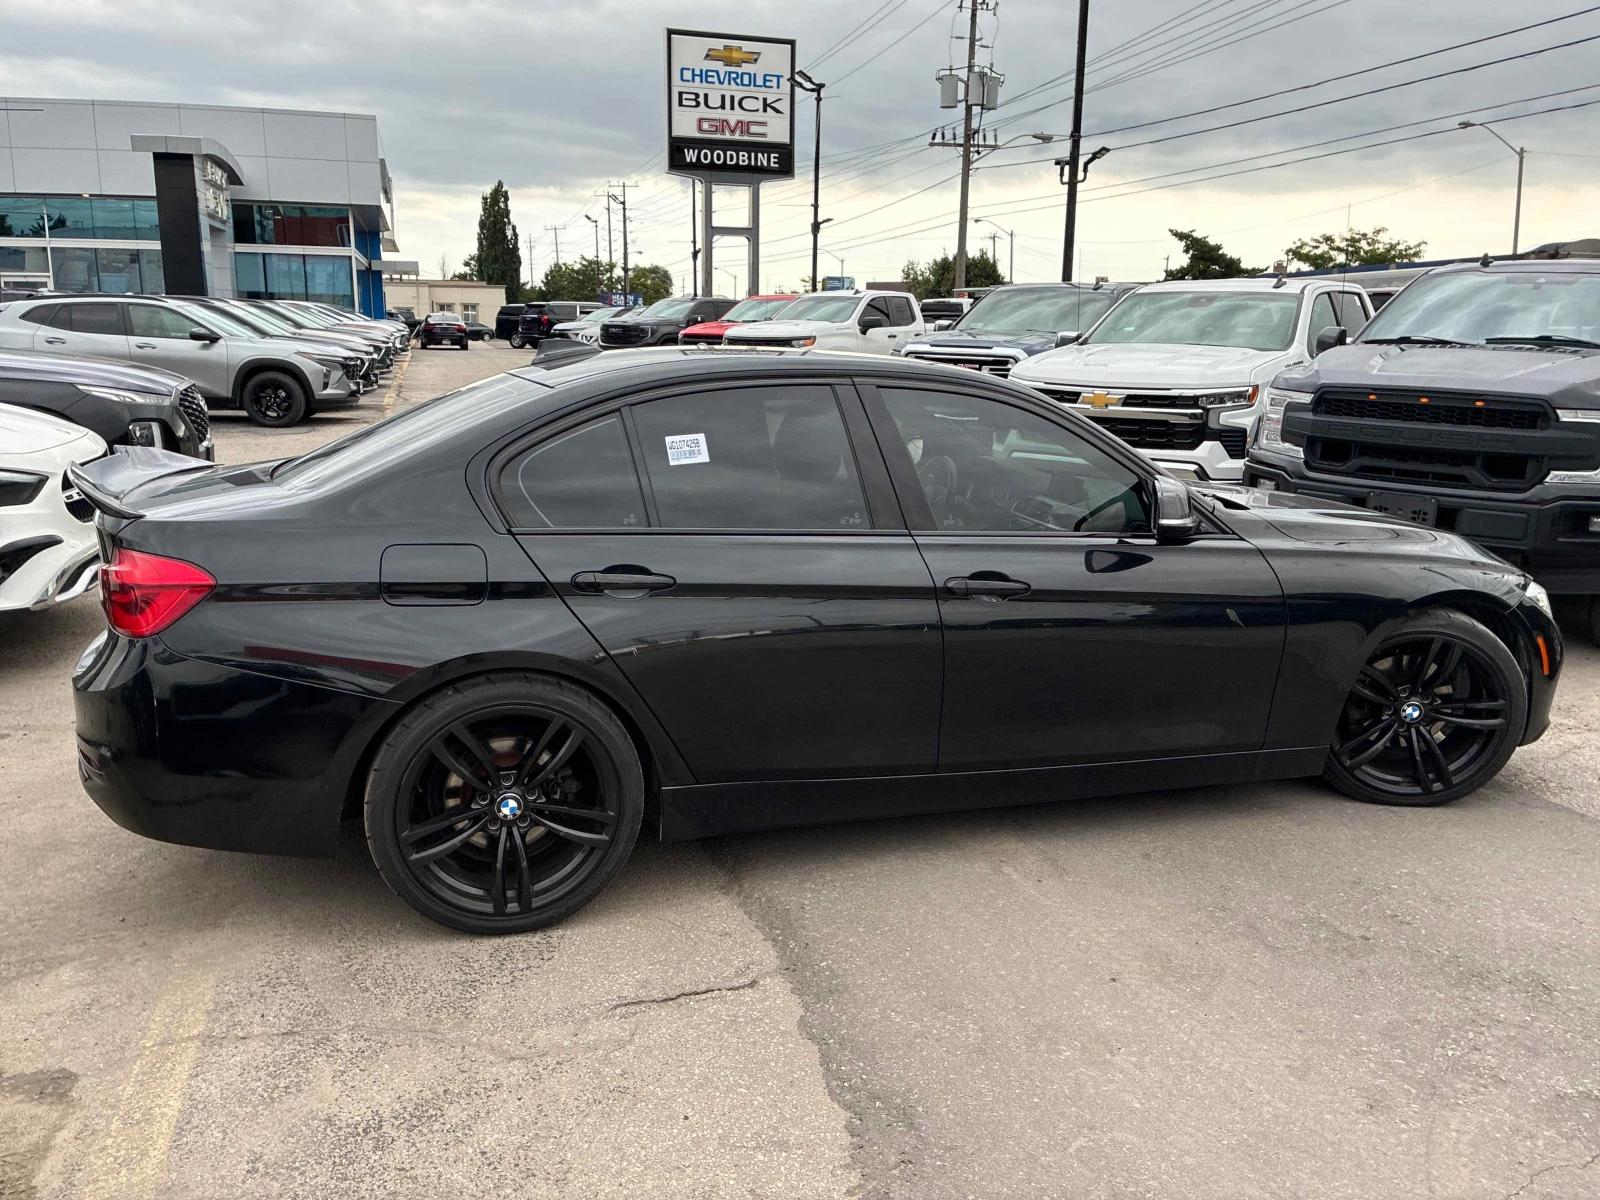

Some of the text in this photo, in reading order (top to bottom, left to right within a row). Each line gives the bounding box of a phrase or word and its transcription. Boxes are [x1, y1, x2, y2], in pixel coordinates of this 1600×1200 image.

[680, 67, 784, 89] CHEVROLET
[677, 91, 785, 115] BUICK
[696, 117, 768, 138] GMC
[684, 148, 780, 167] WOODBINE
